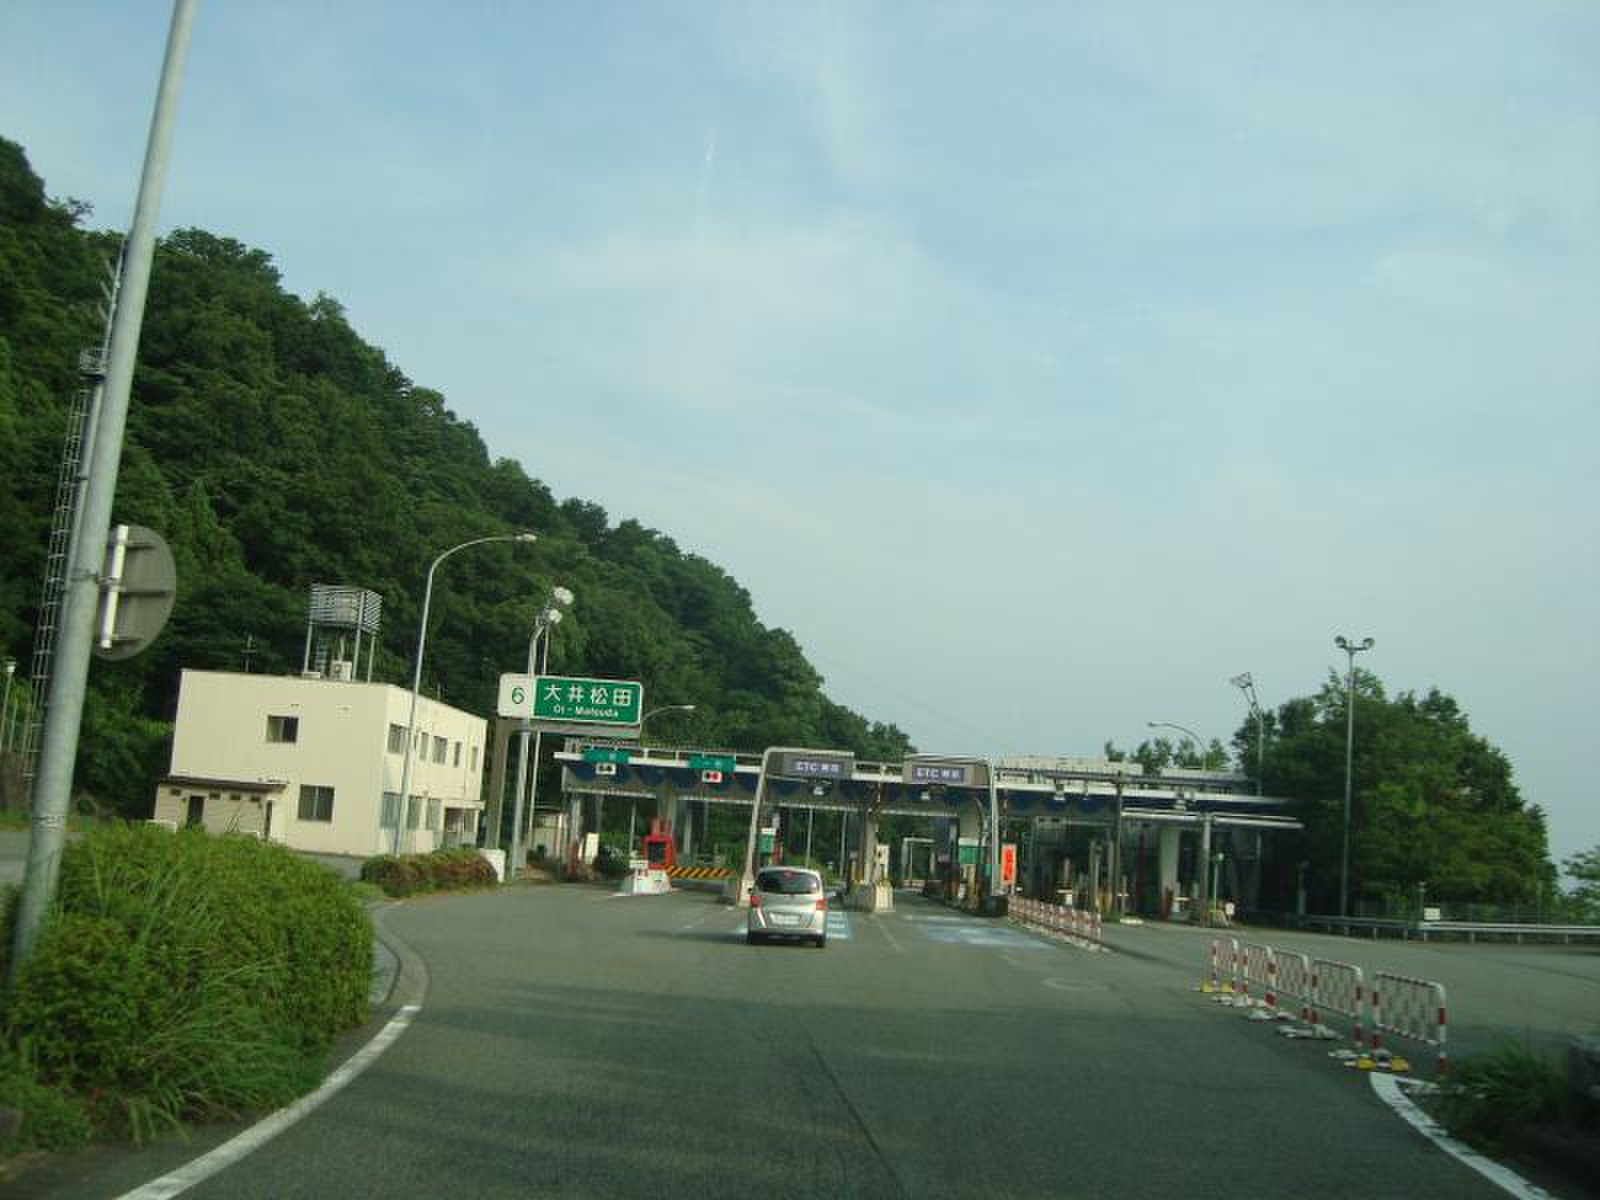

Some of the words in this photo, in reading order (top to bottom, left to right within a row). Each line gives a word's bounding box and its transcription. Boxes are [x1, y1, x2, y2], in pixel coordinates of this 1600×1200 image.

[511, 687, 525, 704] 6
[543, 684, 632, 707] 大井松田
